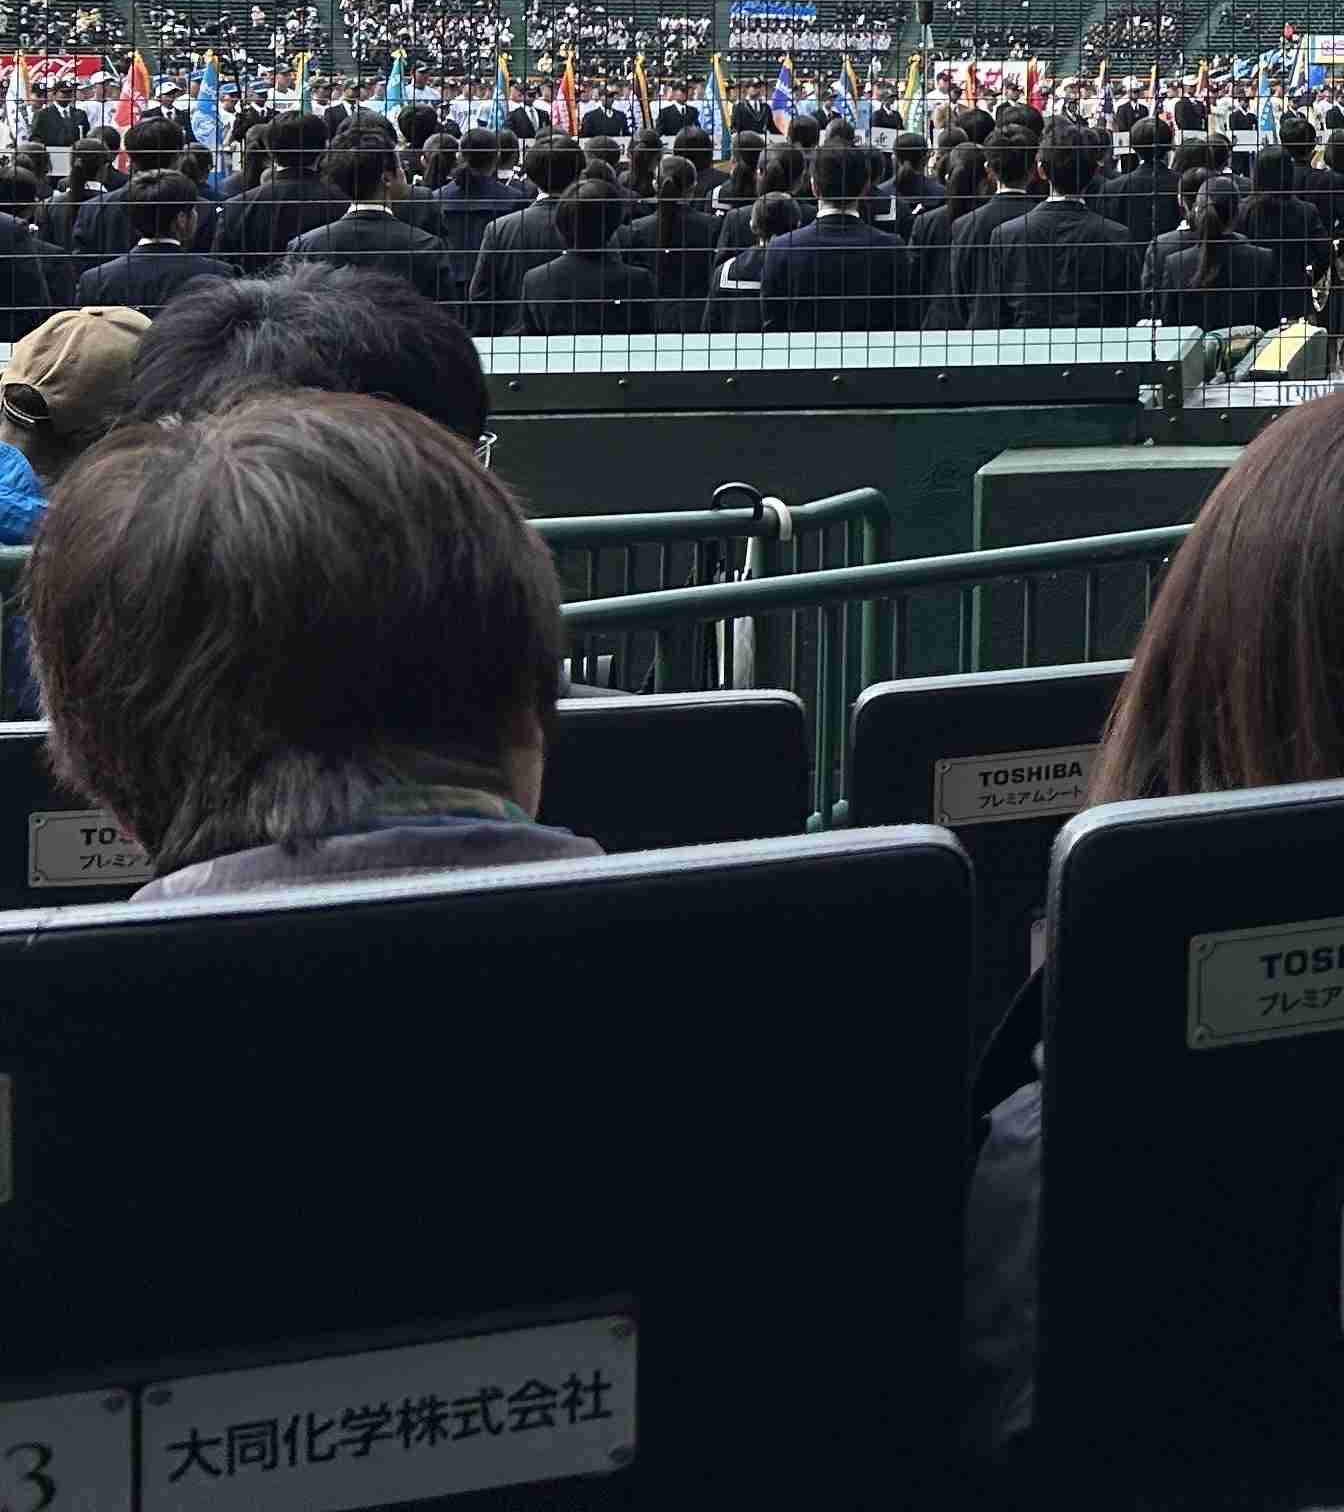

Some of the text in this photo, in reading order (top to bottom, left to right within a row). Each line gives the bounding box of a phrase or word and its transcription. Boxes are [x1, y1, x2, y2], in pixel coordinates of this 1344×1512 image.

[977, 760, 1082, 788] TOSHIBA
[977, 785, 1084, 810] プレミアムシート
[167, 1369, 613, 1484] 大同化学株式会社
